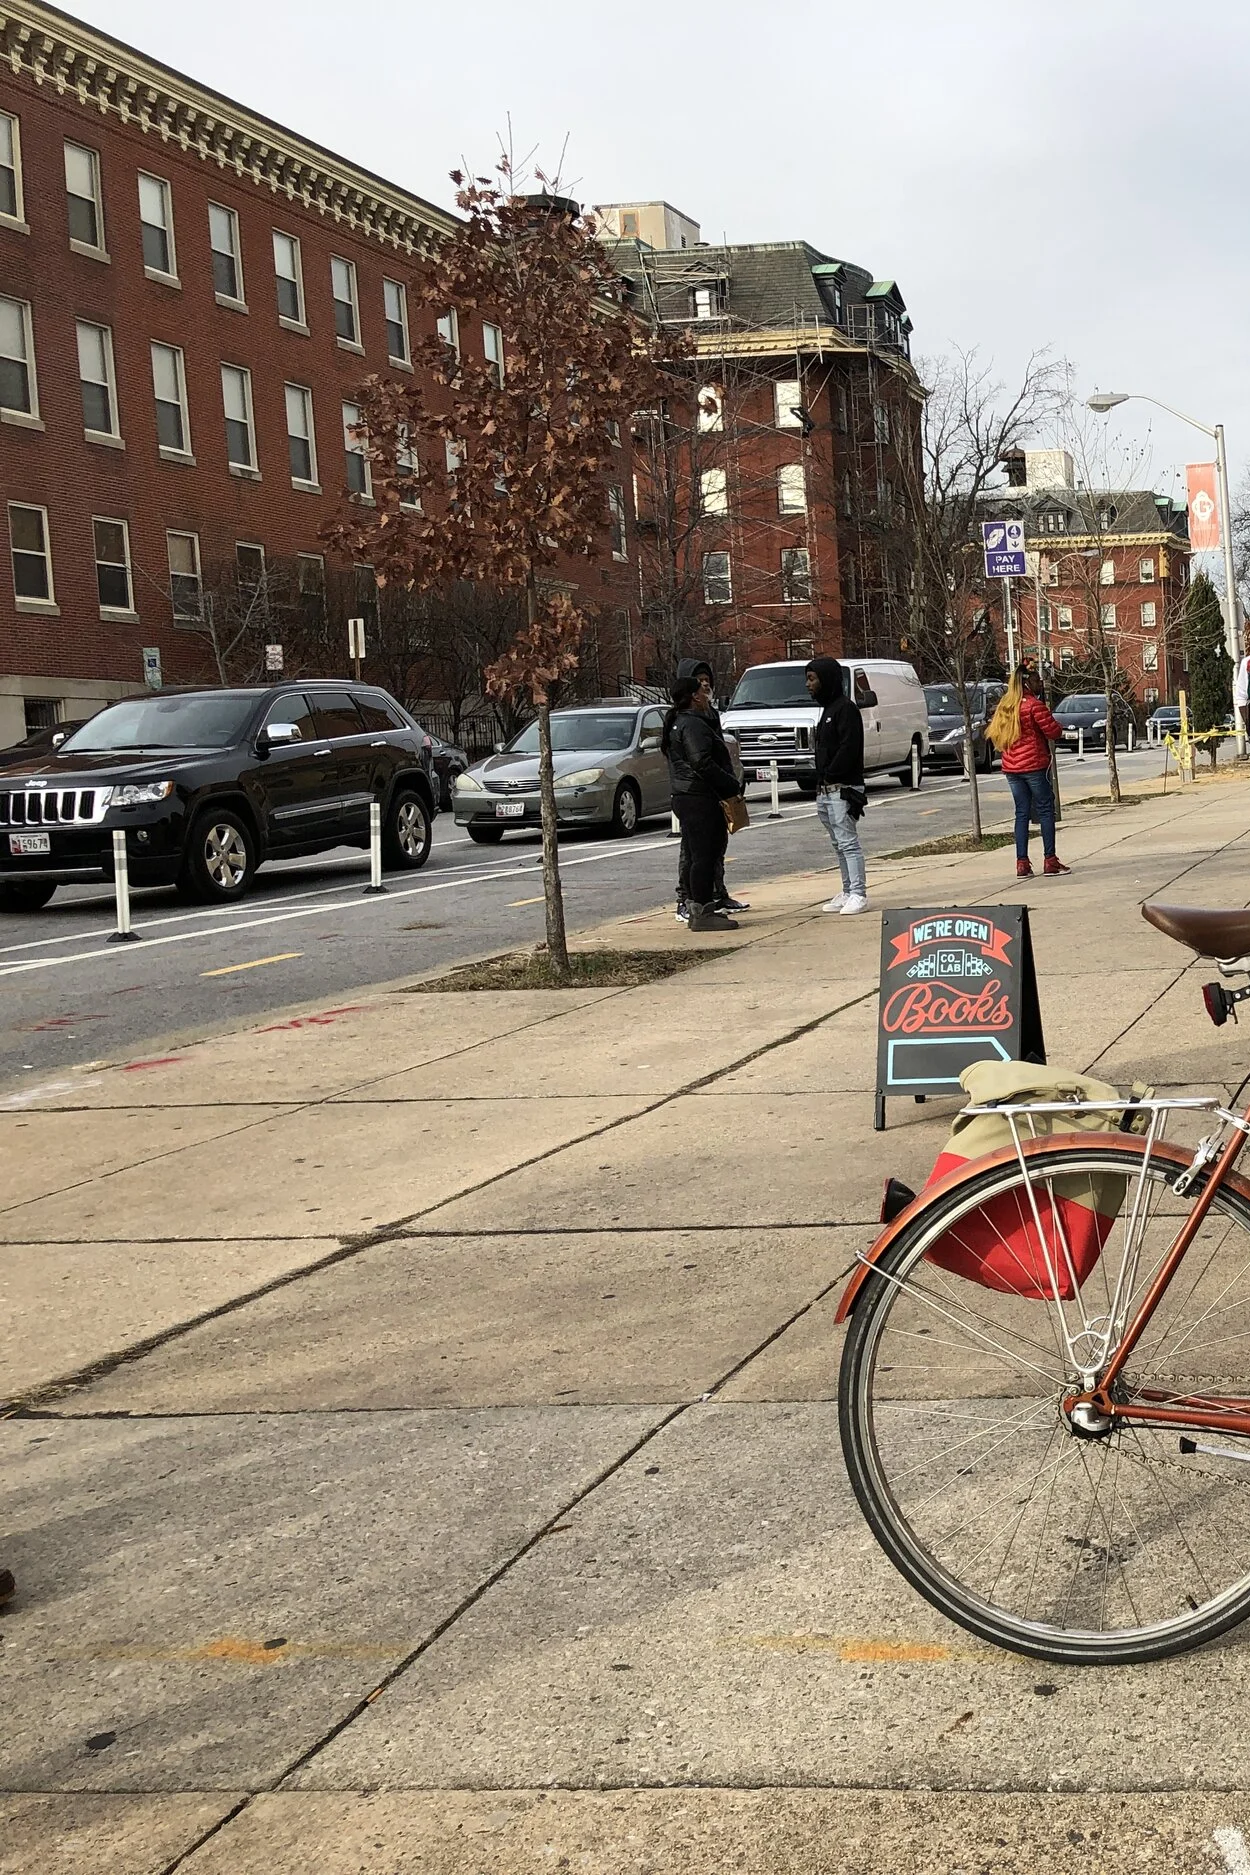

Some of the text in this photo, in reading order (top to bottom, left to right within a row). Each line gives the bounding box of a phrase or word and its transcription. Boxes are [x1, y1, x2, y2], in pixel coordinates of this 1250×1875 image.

[995, 555, 1015, 564] PAY
[992, 564, 1021, 573] HERE
[913, 919, 988, 944] WE'RE OPEN
[940, 963, 961, 973] LAB
[883, 979, 1013, 1033] Books
